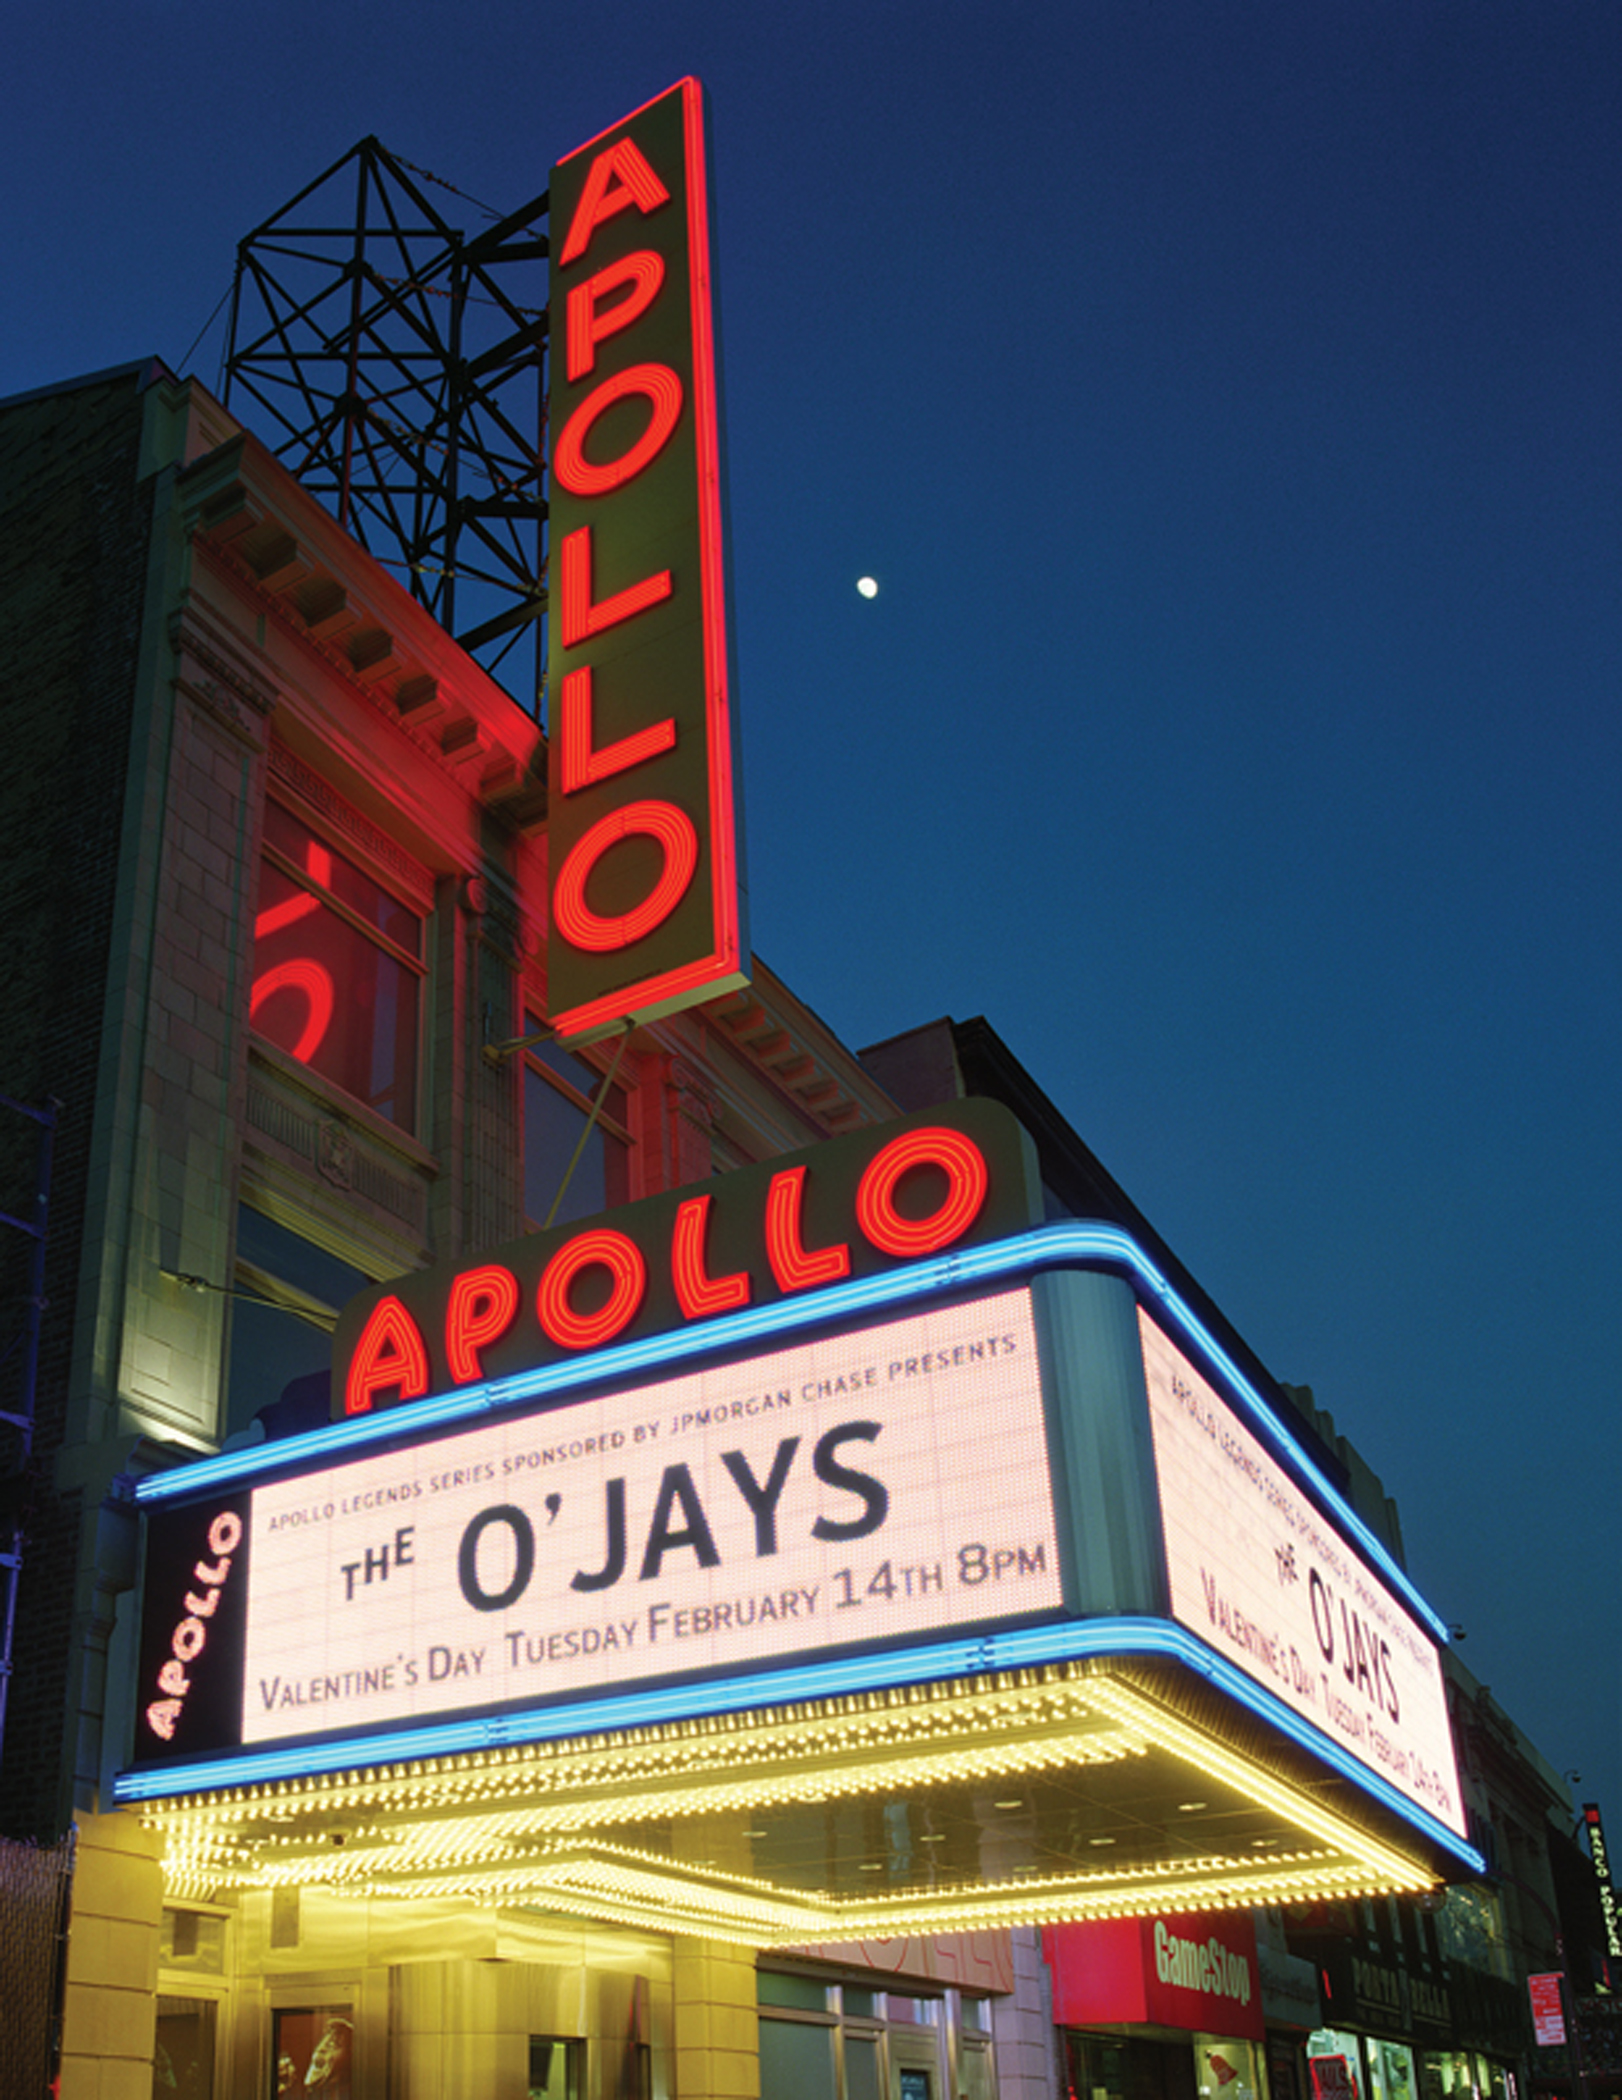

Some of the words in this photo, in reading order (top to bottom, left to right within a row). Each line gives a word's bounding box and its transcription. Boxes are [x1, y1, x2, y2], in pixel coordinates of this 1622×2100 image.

[552, 135, 698, 953] APOLLO
[345, 1126, 988, 1415] APOLLO
[269, 1503, 334, 1531] APOLLO
[342, 1481, 422, 1514] LEGENDS
[430, 1462, 495, 1493] SERIES
[502, 1431, 625, 1475] SPONSORED
[633, 1421, 660, 1443] BY
[669, 1389, 791, 1434] JPMORGAN
[801, 1368, 878, 1401] CHASE
[888, 1333, 1017, 1380] PRESENTS
[340, 1526, 415, 1601] THE
[458, 1420, 889, 1612] O'JAYS
[147, 1511, 242, 1740] APOLLO
[1309, 1567, 1400, 1725] O'JAYS
[1590, 1828, 1608, 1877] BANCO
[1601, 1886, 1622, 1956] POPULAR
[1154, 1920, 1250, 2006] GameStop
